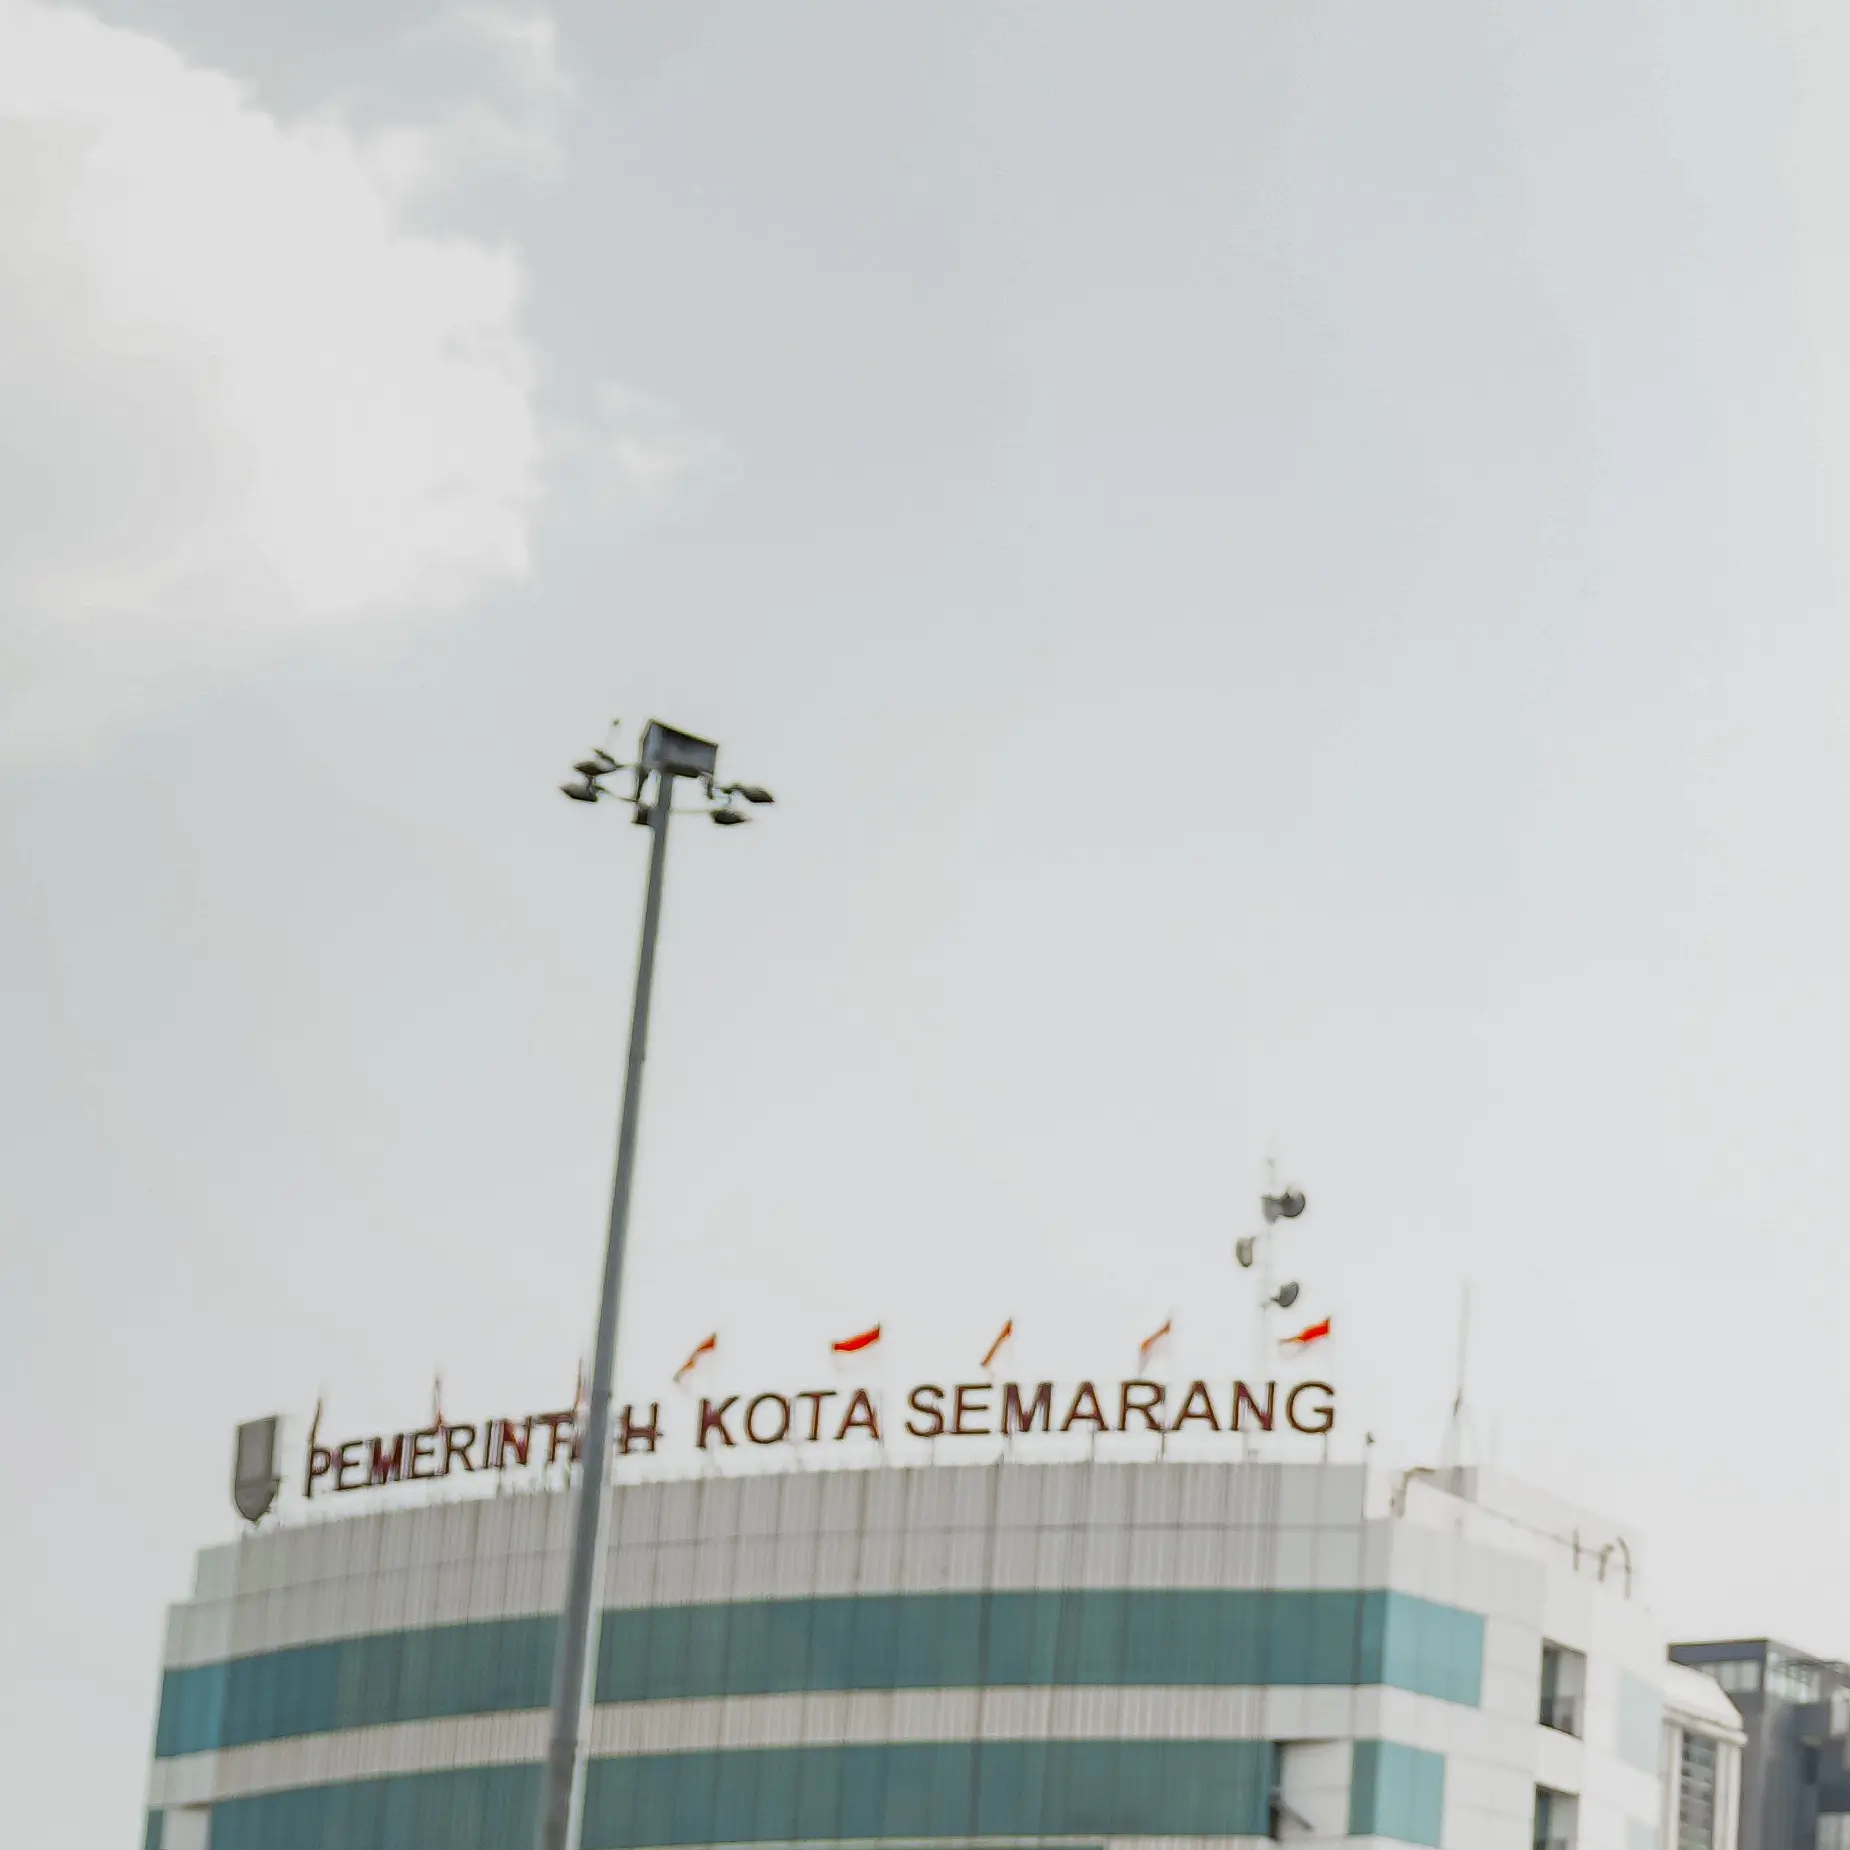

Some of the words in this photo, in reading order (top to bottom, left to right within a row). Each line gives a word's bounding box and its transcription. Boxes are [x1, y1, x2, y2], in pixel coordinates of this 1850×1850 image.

[302, 1402, 661, 1498] PEMERINTH
[696, 1388, 884, 1449] KOTA
[904, 1380, 1337, 1438] SEMARANG
